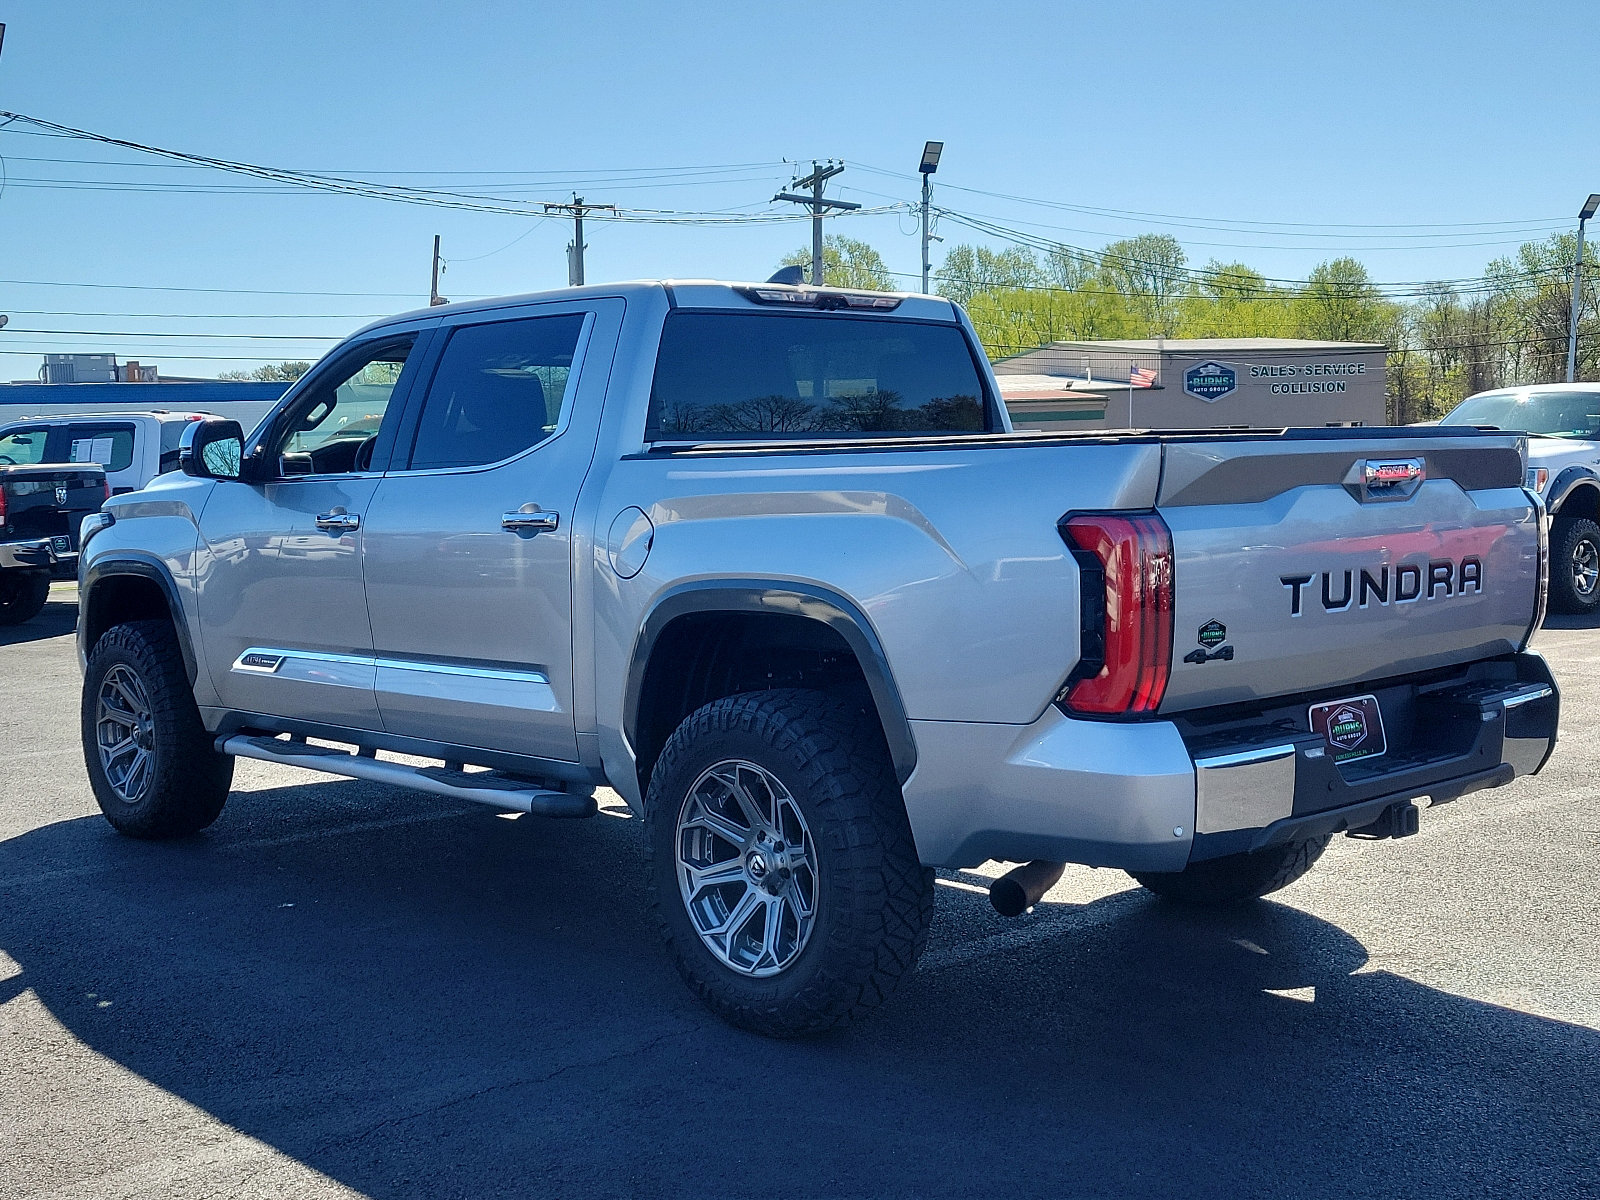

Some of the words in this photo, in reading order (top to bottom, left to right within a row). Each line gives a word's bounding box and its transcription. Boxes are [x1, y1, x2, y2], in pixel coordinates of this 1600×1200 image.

[1250, 364, 1296, 377] SALES
[1304, 363, 1366, 376] SERVICE
[1193, 376, 1229, 386] BURNS
[1270, 381, 1346, 394] COLLISION
[1279, 554, 1484, 617] TUNDRA
